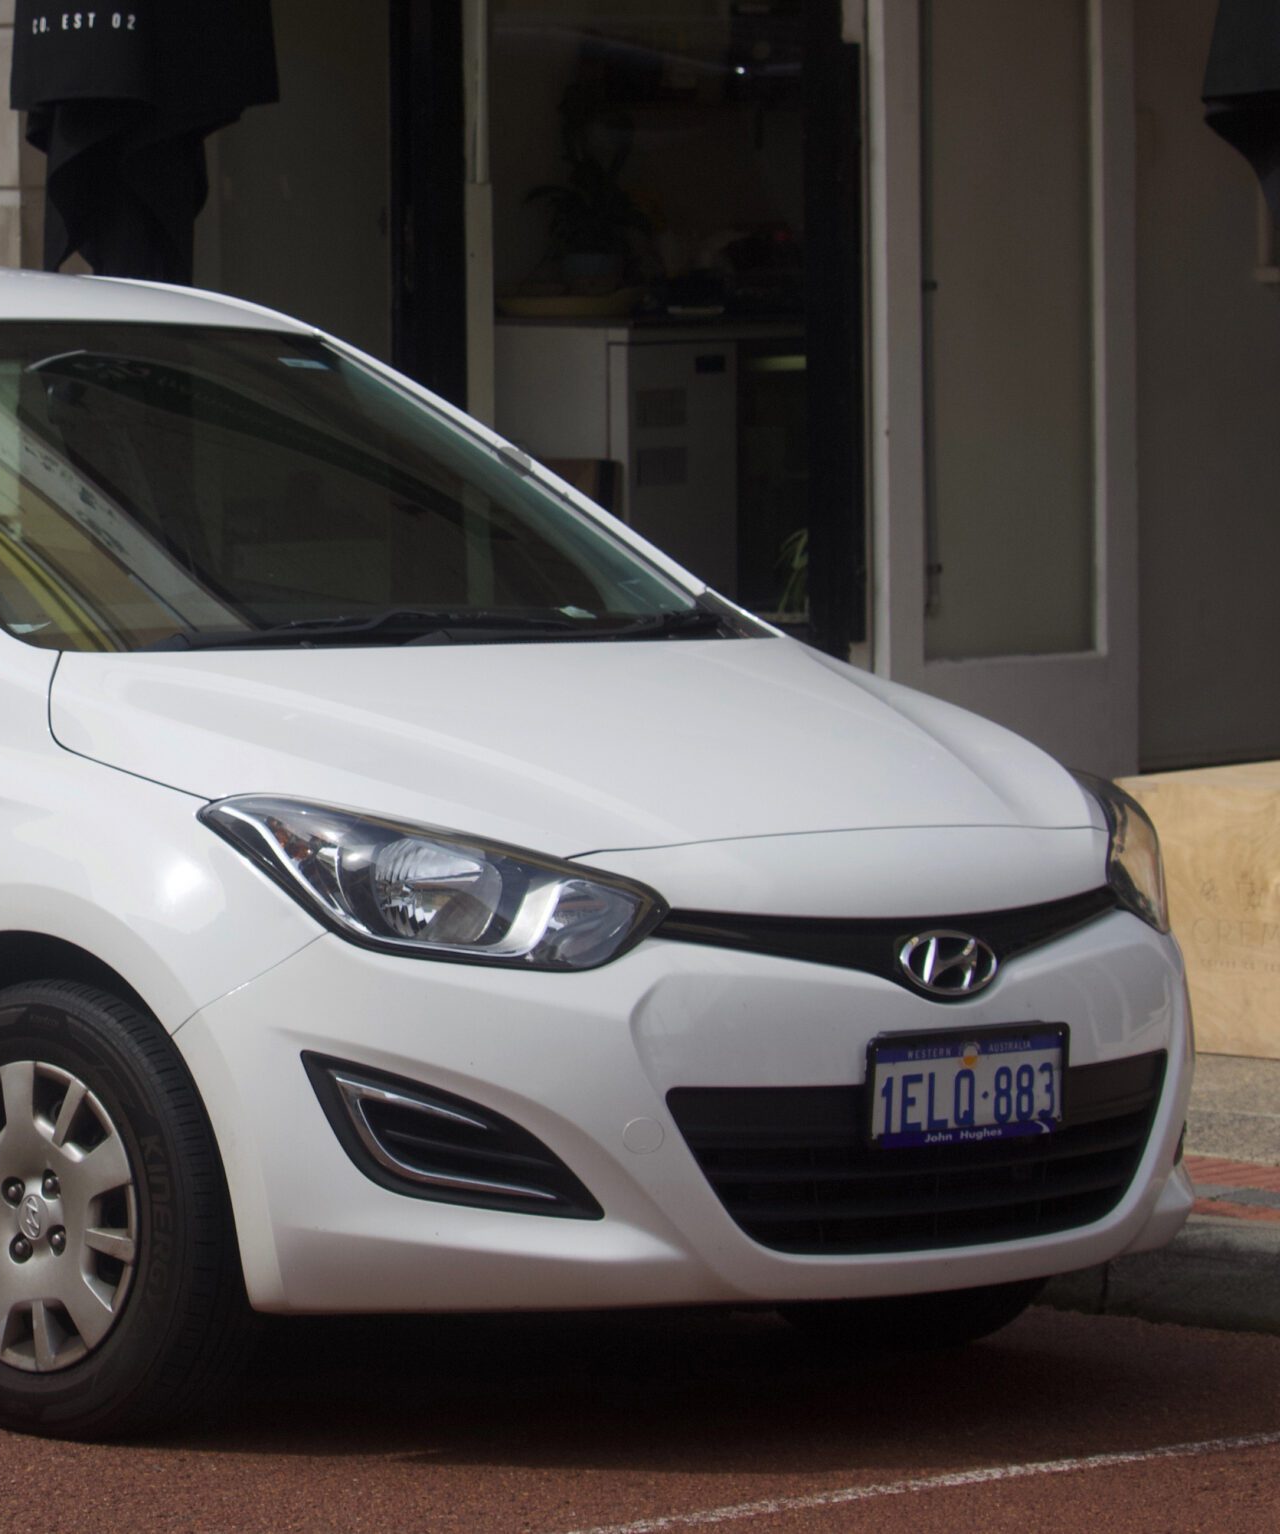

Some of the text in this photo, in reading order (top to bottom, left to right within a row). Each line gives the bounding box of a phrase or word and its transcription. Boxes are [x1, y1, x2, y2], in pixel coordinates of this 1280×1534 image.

[61, 12, 96, 30] EST
[907, 1040, 1031, 1059] WESTERN AUSTRALIA
[924, 1128, 1002, 1143] John Hughes
